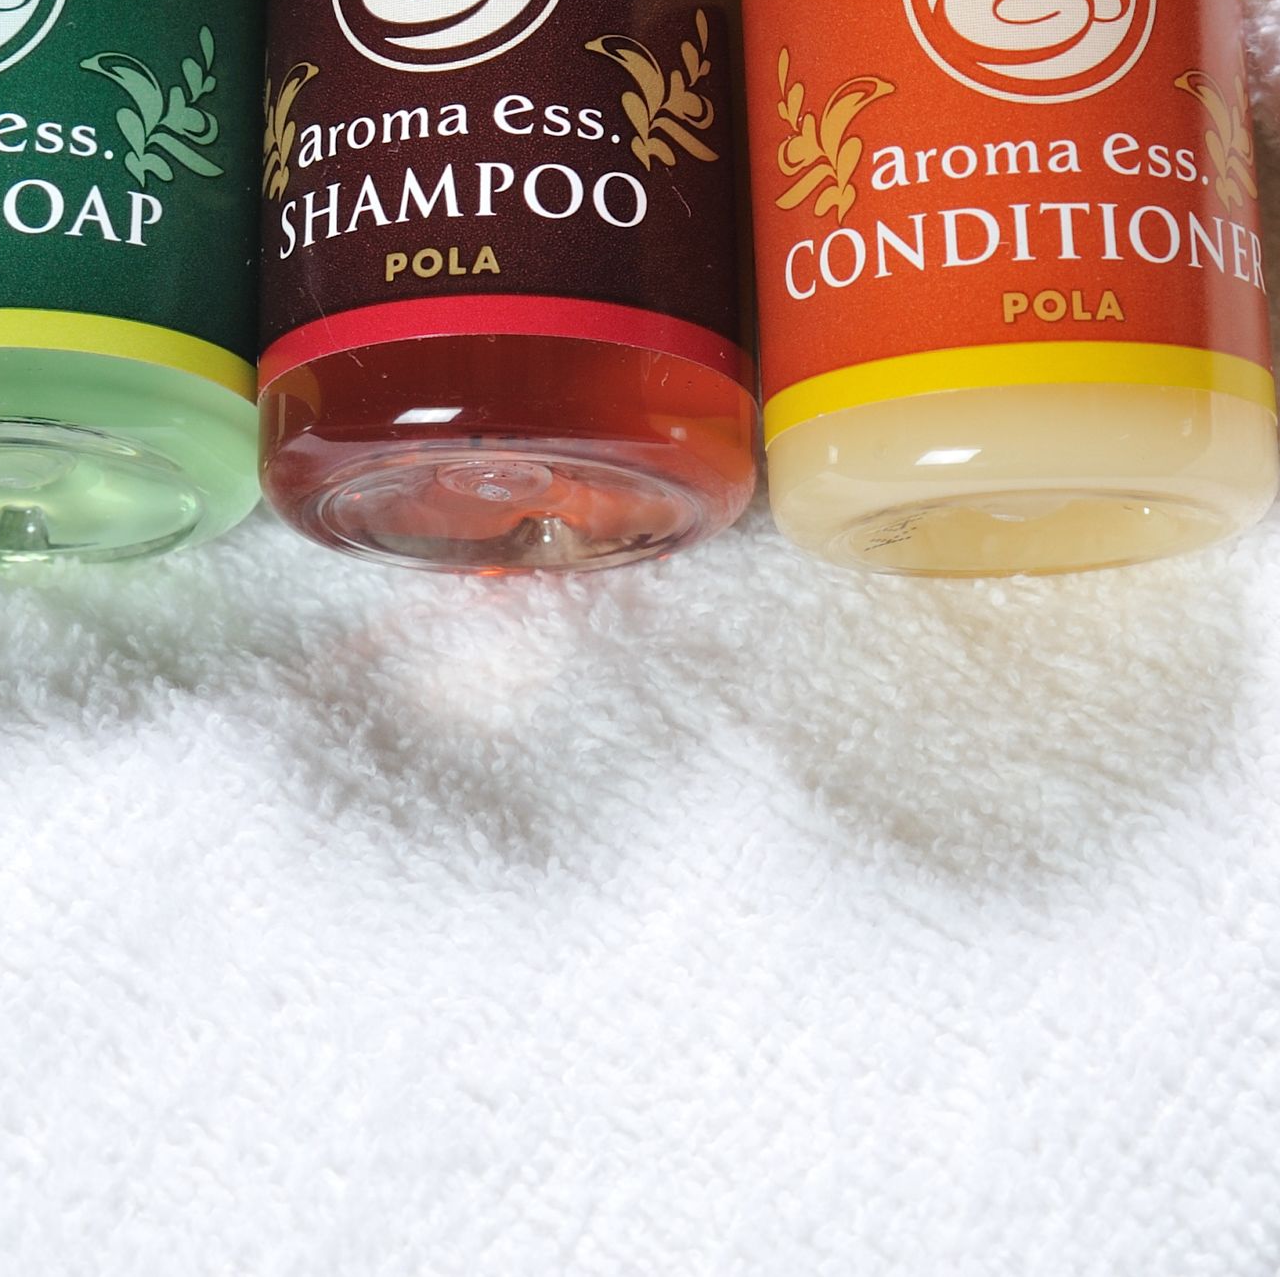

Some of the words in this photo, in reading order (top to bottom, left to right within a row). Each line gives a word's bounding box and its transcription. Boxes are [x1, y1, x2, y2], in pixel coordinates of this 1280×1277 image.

[298, 101, 468, 169] aroma
[493, 94, 621, 144] ess.
[871, 139, 1082, 191] aroma
[1102, 132, 1209, 186] ess.
[279, 162, 648, 260] SHAMPOO
[385, 244, 501, 282] POLA
[784, 202, 1267, 300] CONDITIONER
[1002, 289, 1124, 323] POLA
